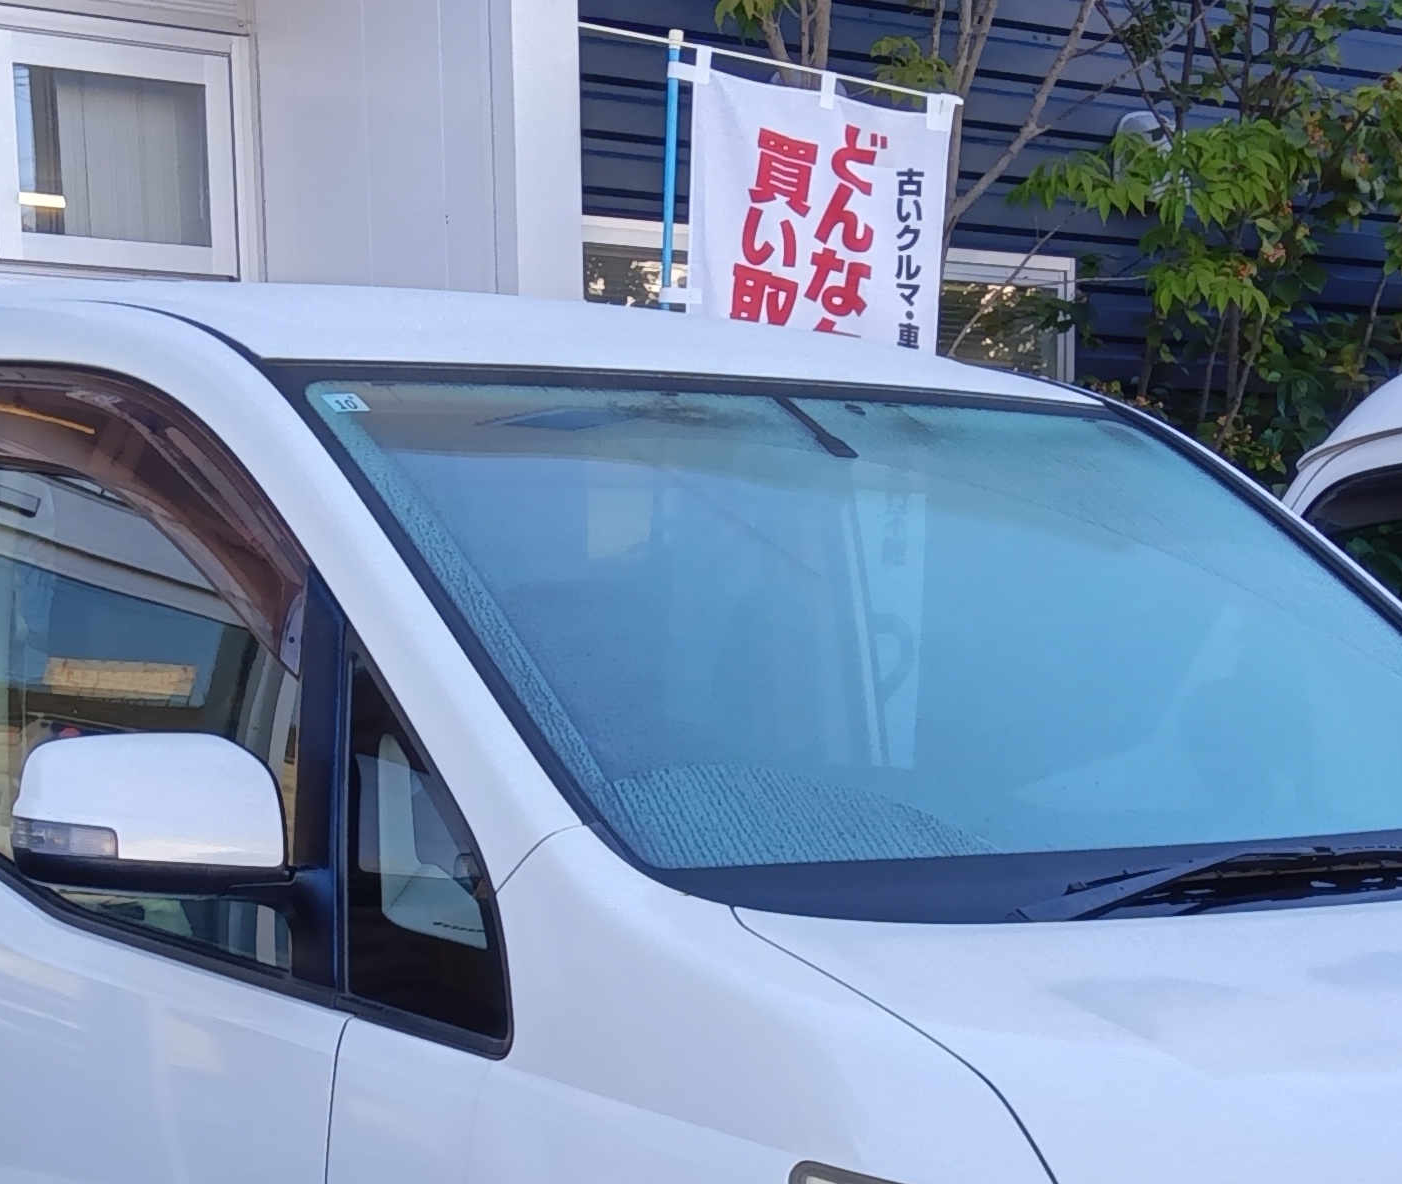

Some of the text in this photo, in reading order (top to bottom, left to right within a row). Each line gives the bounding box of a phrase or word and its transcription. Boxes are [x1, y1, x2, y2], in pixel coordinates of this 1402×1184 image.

[730, 127, 818, 326] 買い取
[894, 168, 925, 349] 古いクルマ・車
